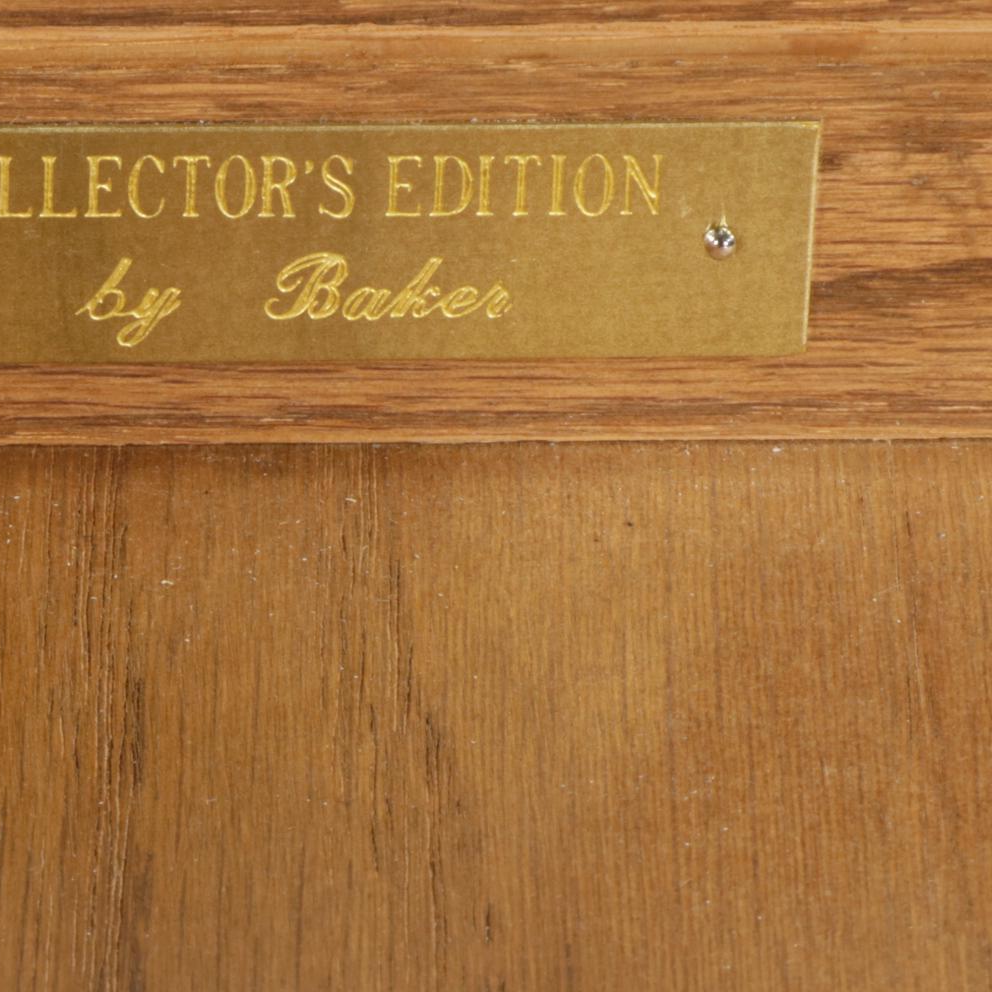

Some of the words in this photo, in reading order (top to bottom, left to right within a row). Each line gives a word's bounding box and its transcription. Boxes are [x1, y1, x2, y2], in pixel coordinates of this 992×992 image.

[385, 153, 664, 218] EDITION
[75, 256, 182, 347] by
[263, 252, 513, 321] Baker
